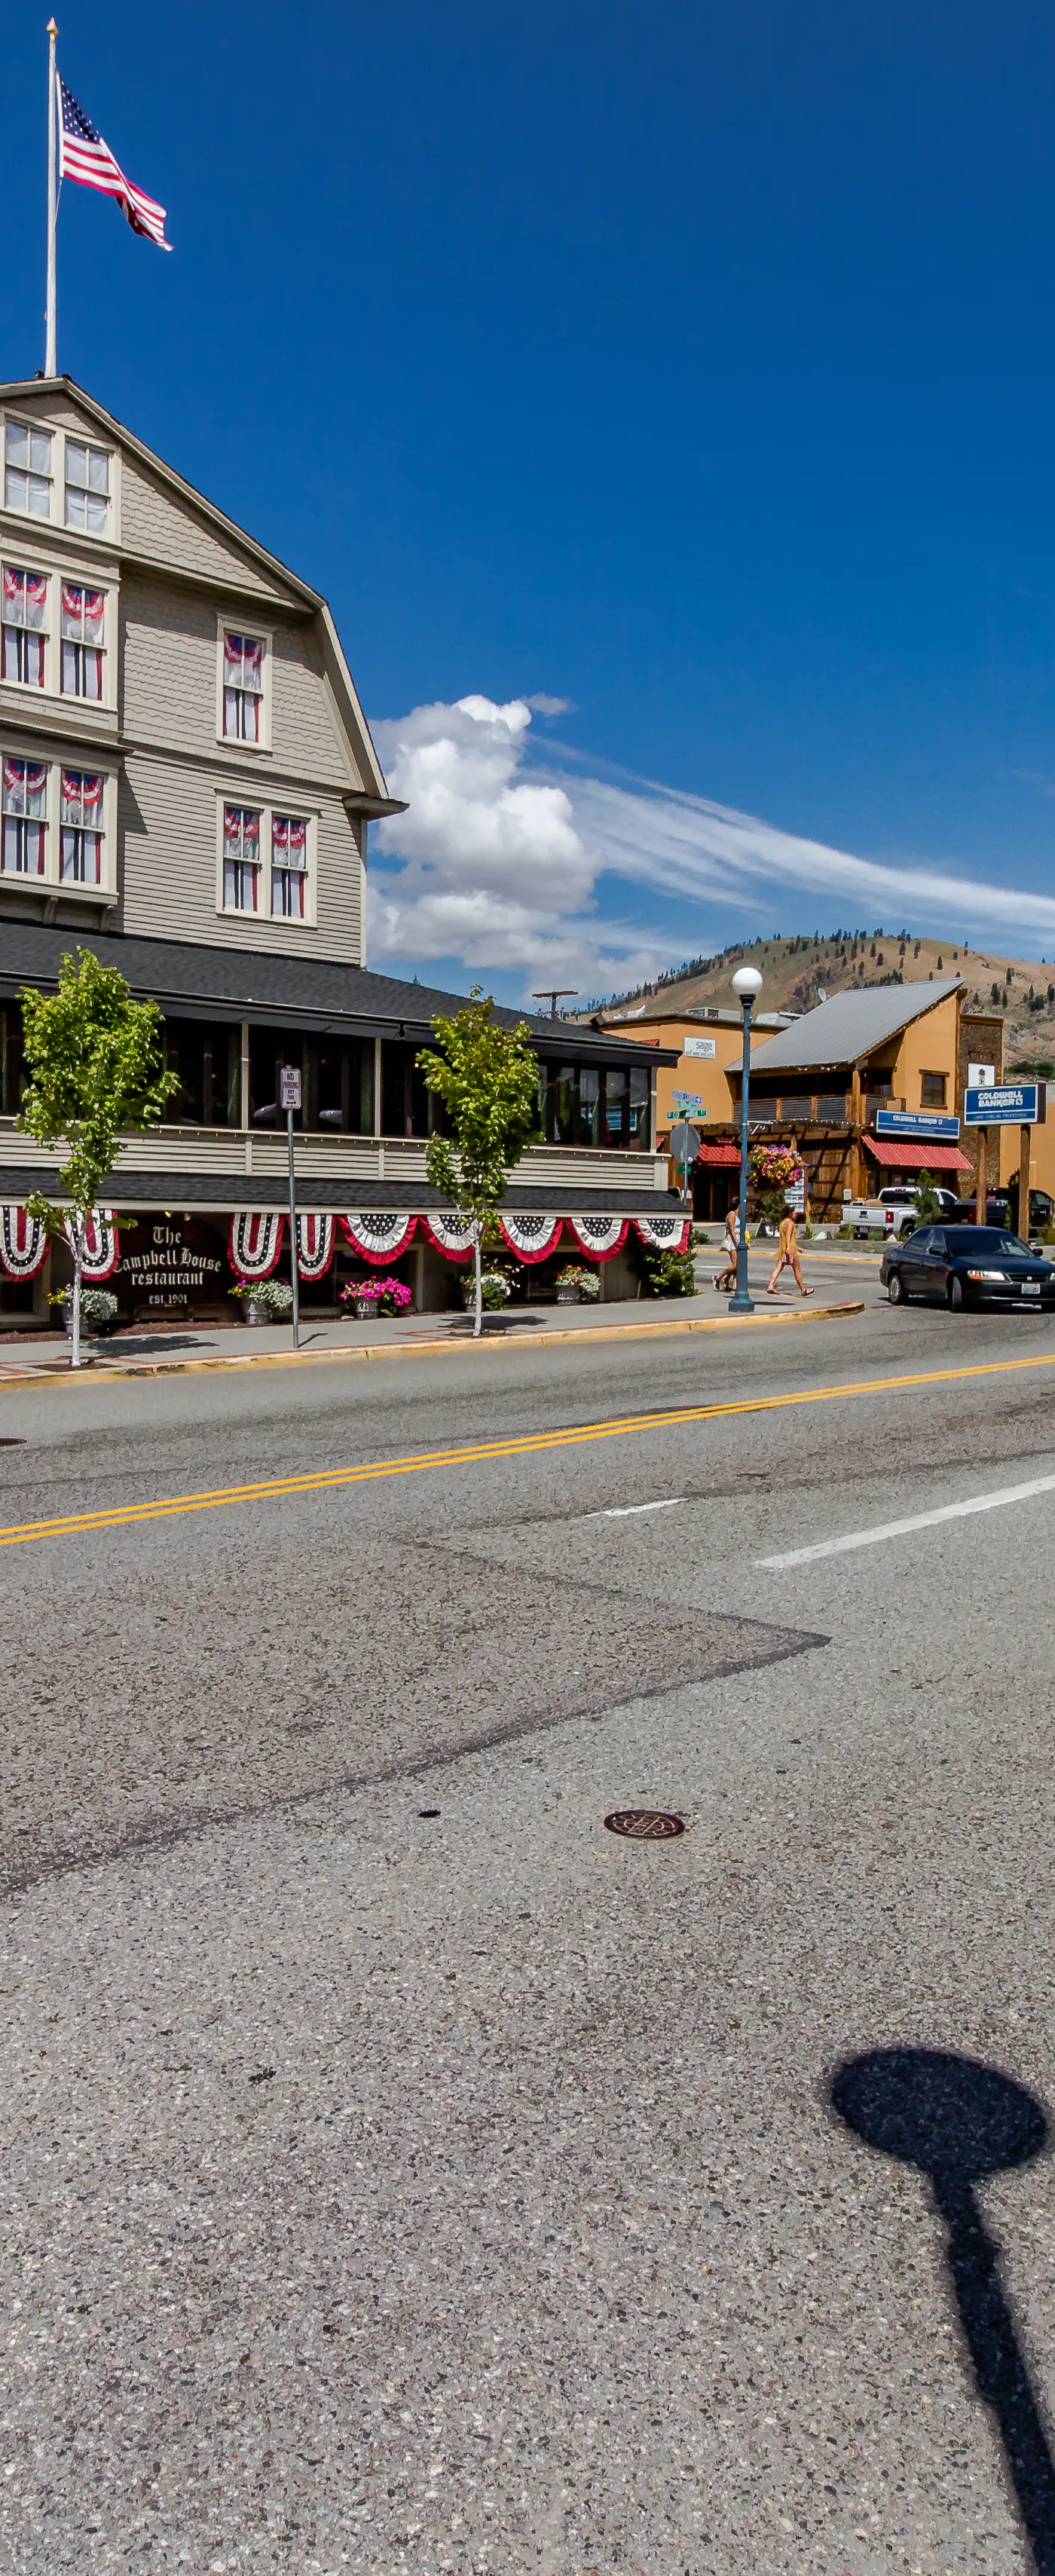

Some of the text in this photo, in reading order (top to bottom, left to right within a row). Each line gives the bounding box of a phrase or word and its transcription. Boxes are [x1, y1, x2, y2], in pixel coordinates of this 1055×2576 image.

[696, 1042, 713, 1052] sage
[152, 1226, 182, 1246] The
[180, 1247, 222, 1272] House
[131, 1271, 204, 1286] restaurant
[168, 1294, 188, 1305] 1901
